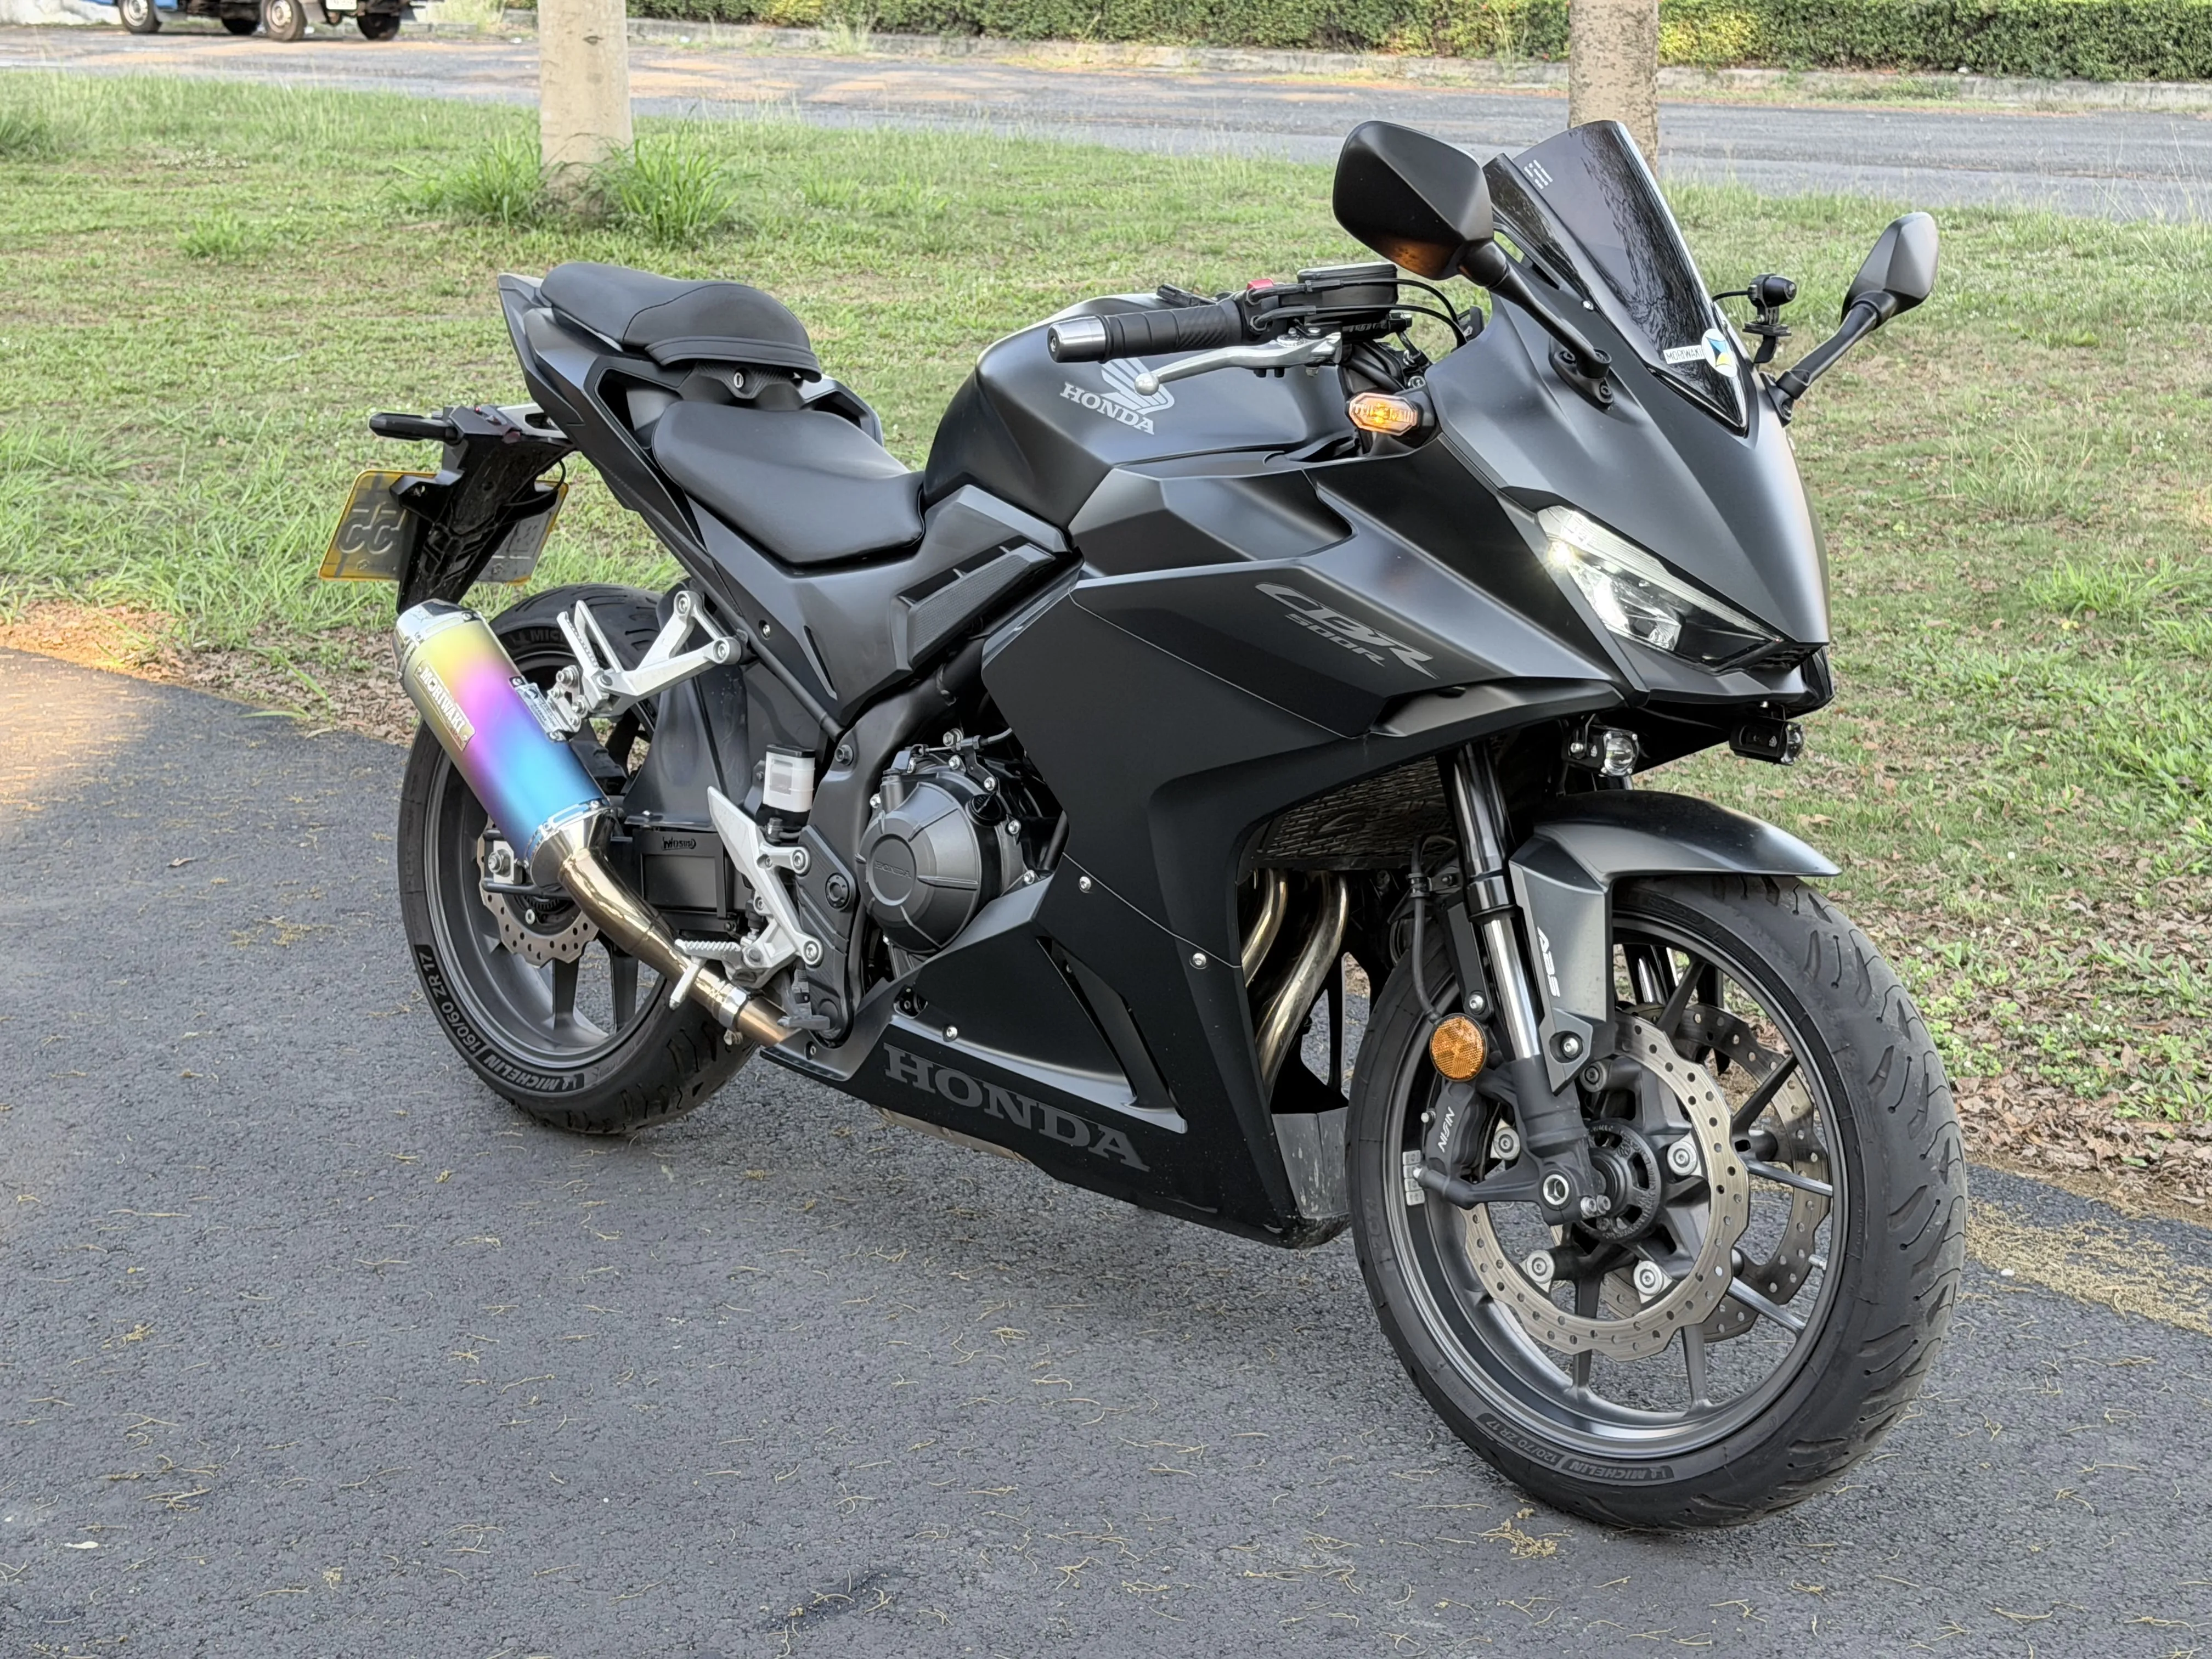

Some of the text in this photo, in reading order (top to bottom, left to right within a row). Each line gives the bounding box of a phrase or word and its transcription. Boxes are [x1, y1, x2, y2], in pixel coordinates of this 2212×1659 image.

[1666, 347, 1703, 362] MORIWAKI
[1059, 382, 1155, 435] HONDA
[1255, 582, 1440, 680] CBR
[1285, 613, 1385, 668] 500R
[420, 667, 466, 734] MORIWAKI
[1537, 926, 1561, 997] ABS
[419, 952, 481, 1052] 160/60 ZR 17
[483, 1053, 561, 1091] MICHELIN
[883, 1043, 1150, 1172] HONDA
[1437, 1105, 1455, 1153] NISSIN
[1485, 1420, 1558, 1463] 120/70 ZR 17
[1569, 1461, 1646, 1480] MICHELIN
